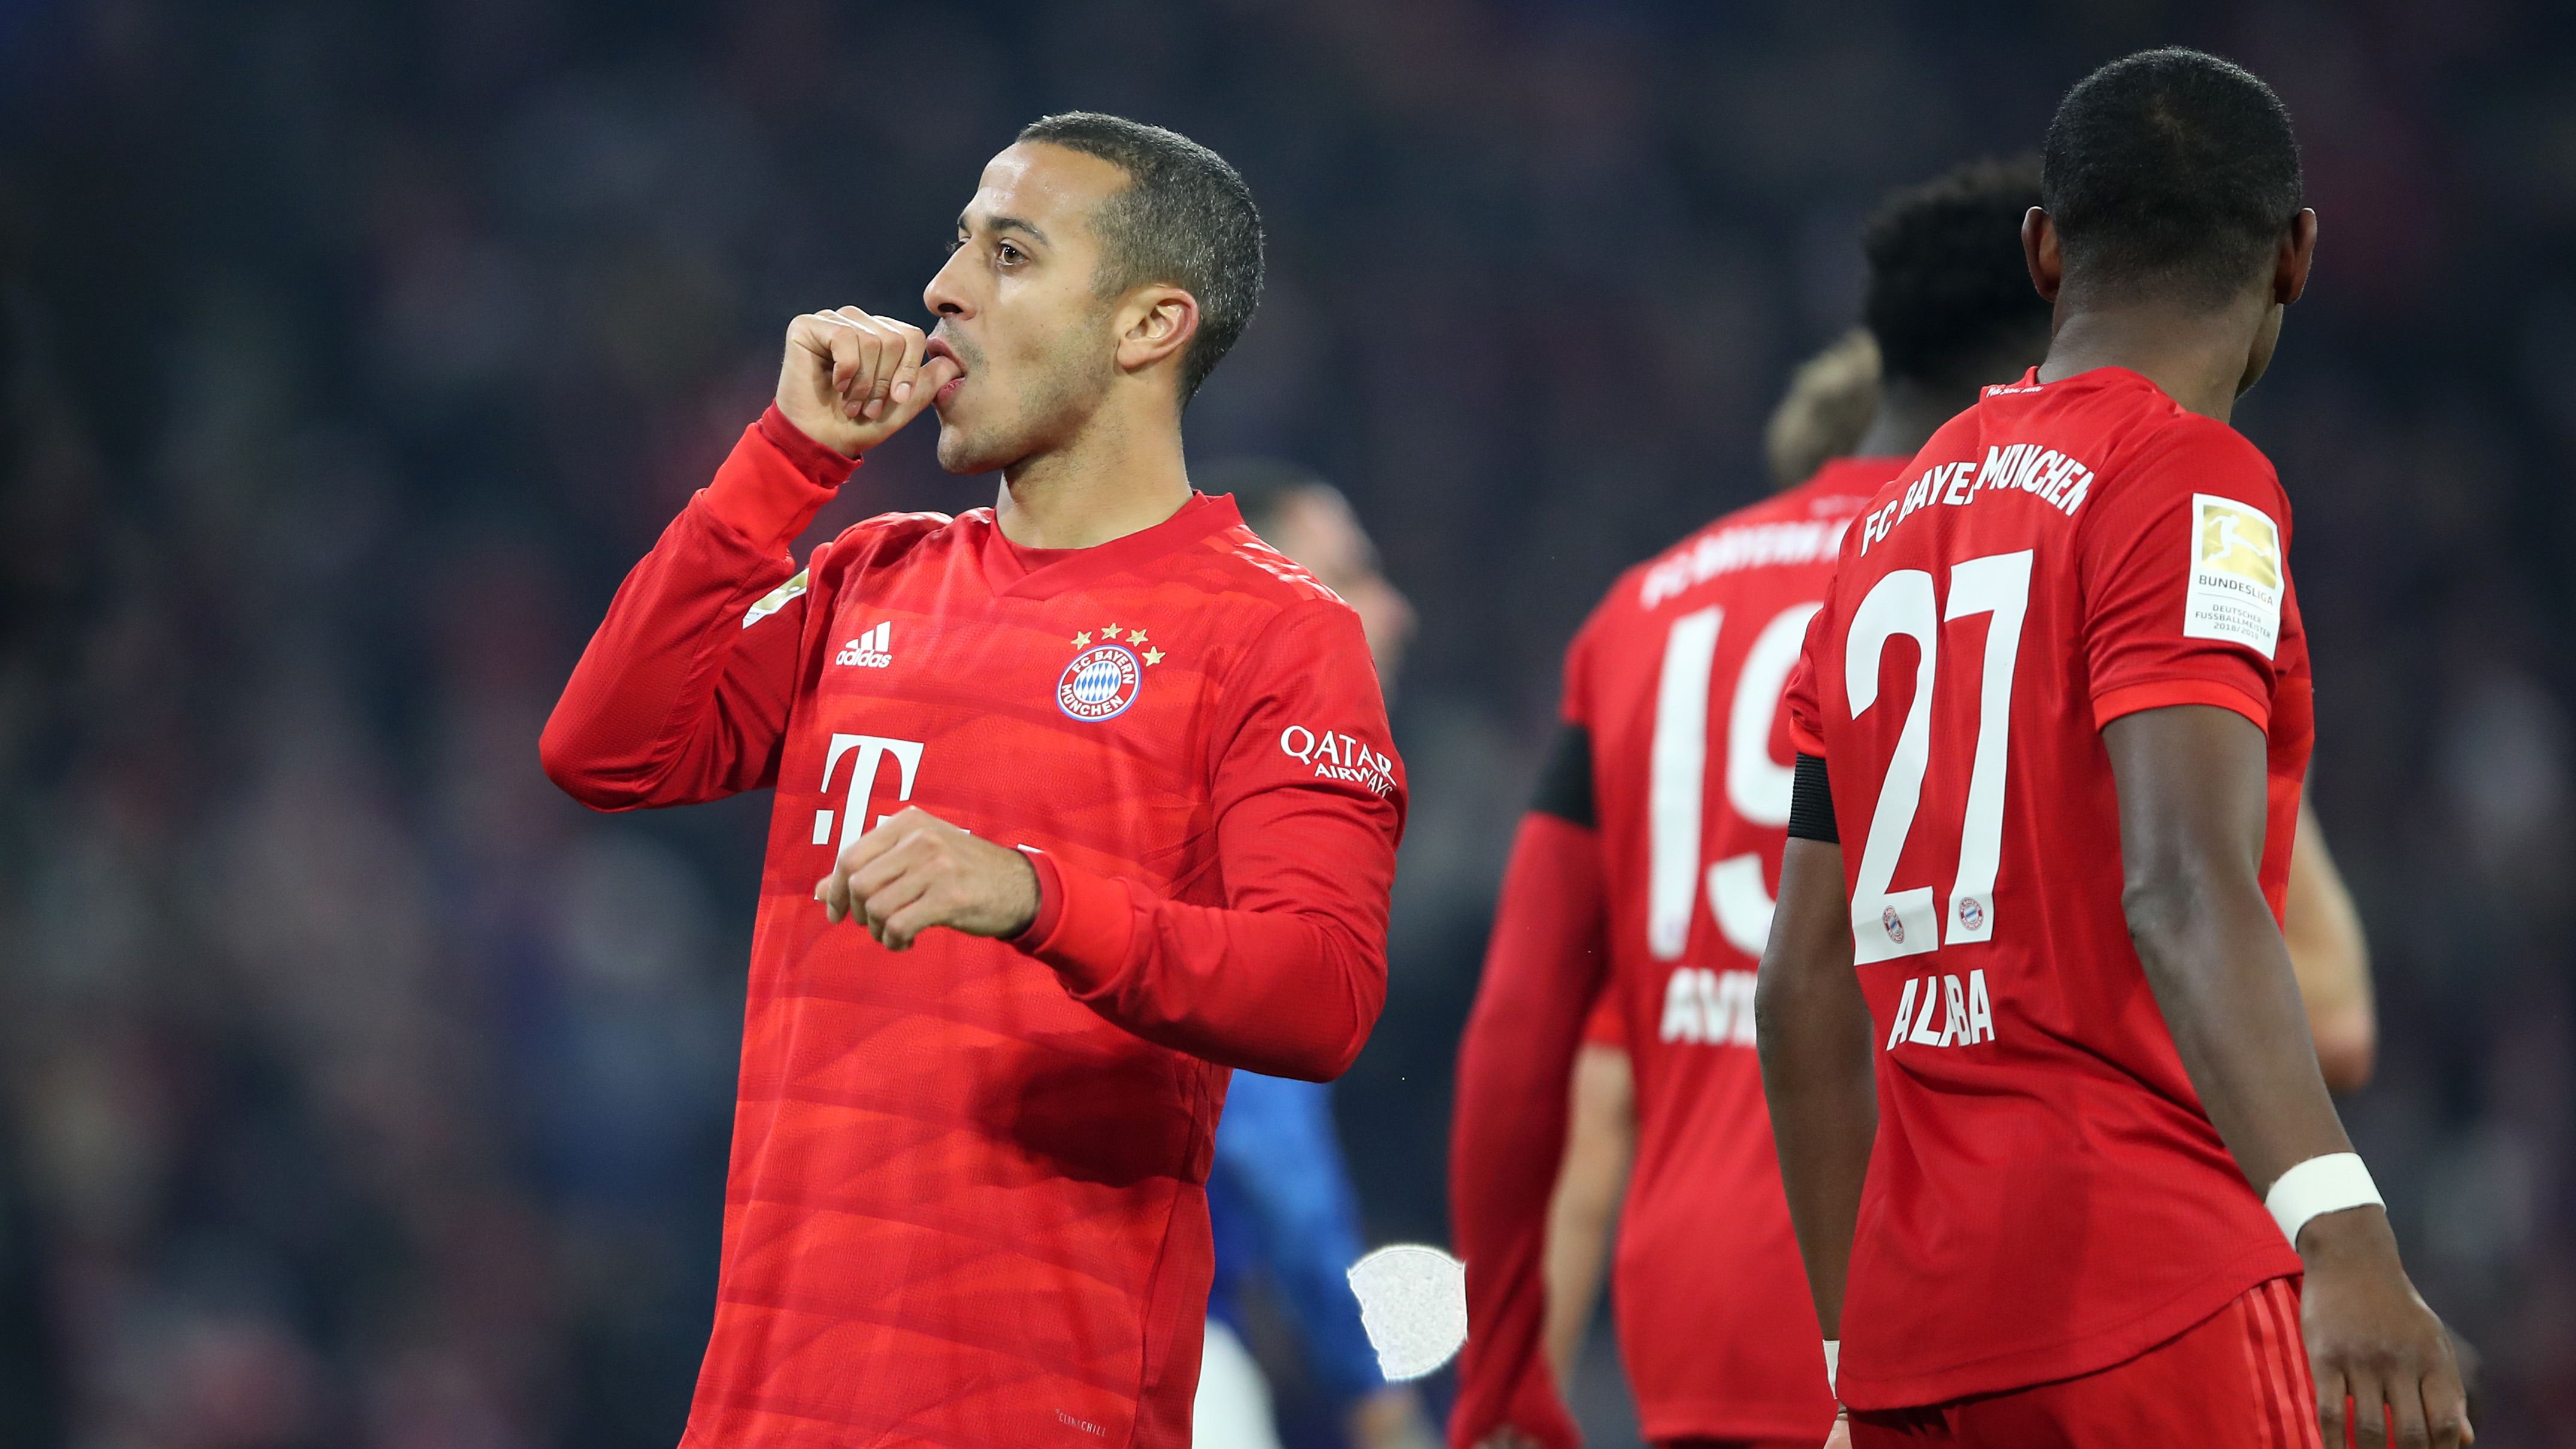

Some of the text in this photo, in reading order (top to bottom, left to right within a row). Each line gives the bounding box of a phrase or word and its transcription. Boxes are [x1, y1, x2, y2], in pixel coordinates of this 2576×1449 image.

[1860, 500, 1898, 558] FC
[1896, 461, 1977, 527] BAYE
[2199, 575, 2274, 606] BUNDESLIGA
[2212, 604, 2262, 624] DEUTSCHER
[836, 648, 892, 668] adidas
[1072, 650, 1134, 684] FC BAYERN
[1061, 683, 1124, 716] MÜNCHEN
[1280, 725, 1397, 786] QATAR
[1845, 549, 2033, 966] 27
